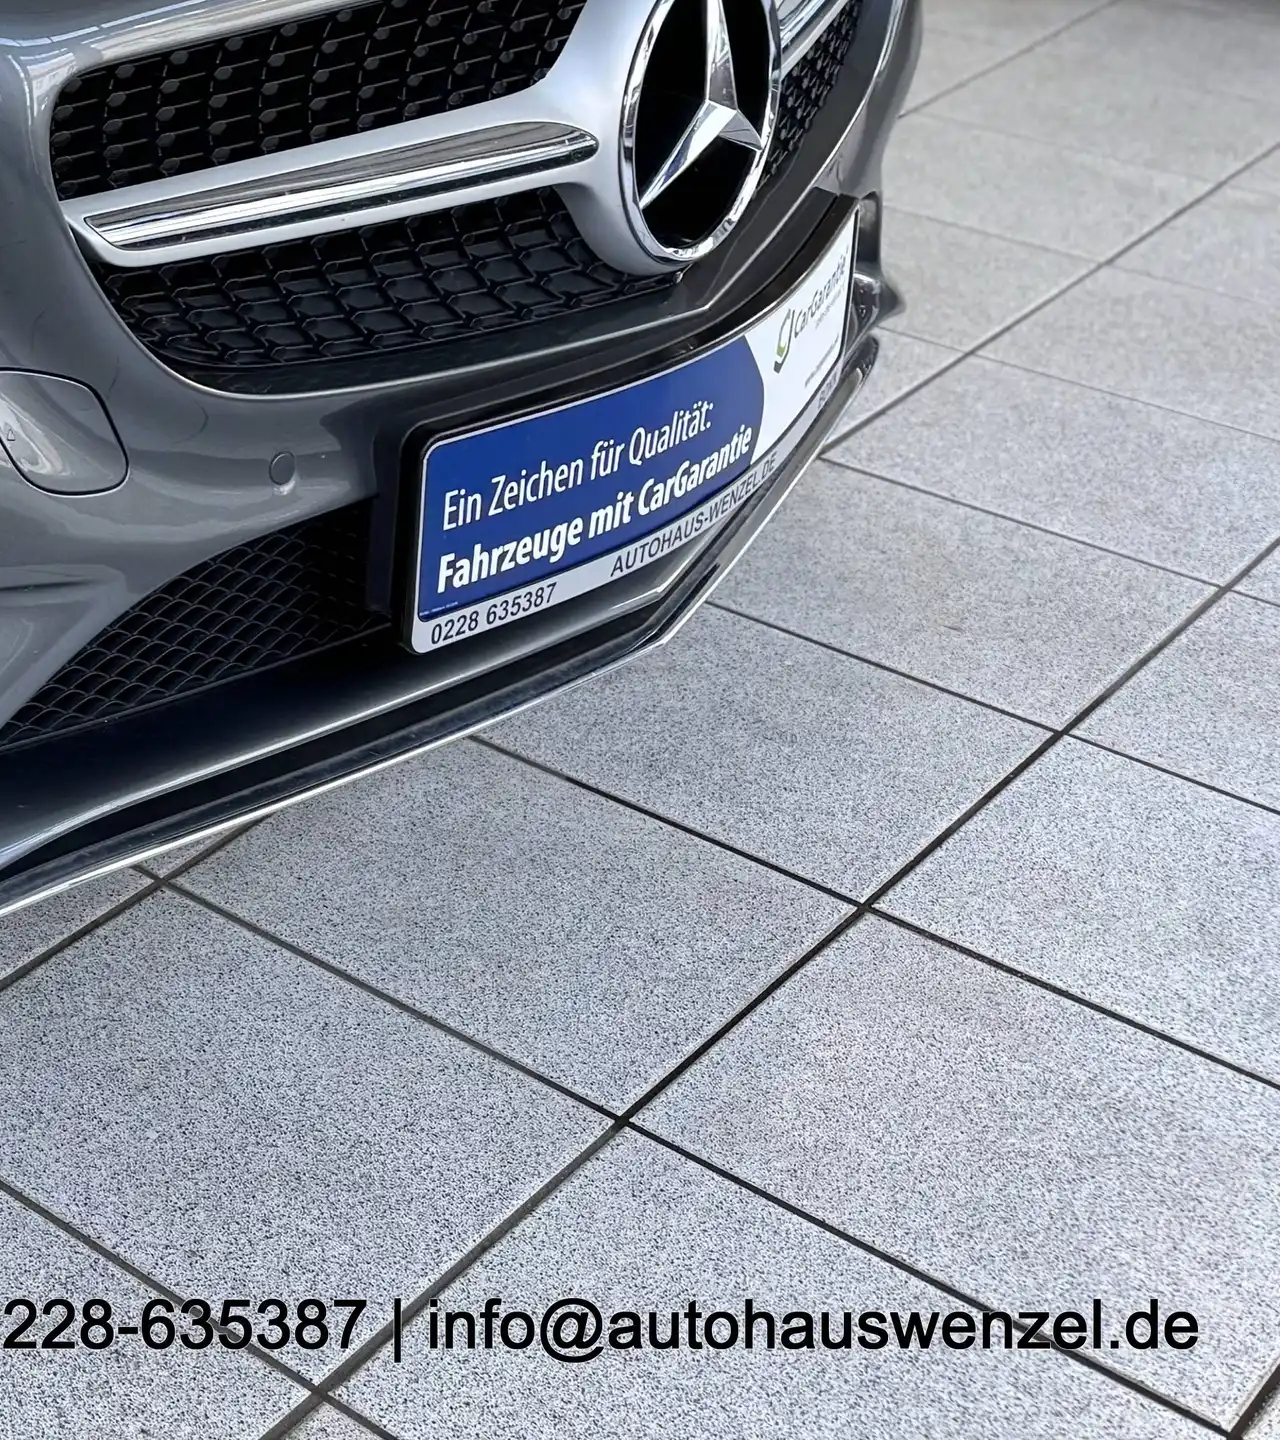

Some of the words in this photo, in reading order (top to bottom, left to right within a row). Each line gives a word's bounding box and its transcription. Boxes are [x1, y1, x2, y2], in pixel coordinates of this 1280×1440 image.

[437, 516, 583, 594] Fahrzeuge
[588, 491, 635, 539] mit
[638, 424, 752, 516] CarGarantie
[443, 489, 482, 531] Ein
[488, 460, 584, 517] Zeichen
[590, 439, 625, 481] für
[629, 401, 714, 466] Qualität:
[610, 451, 778, 577] AUTOHAUS-WENZEL.DE
[431, 611, 479, 645] 0228
[486, 582, 557, 625] 635387
